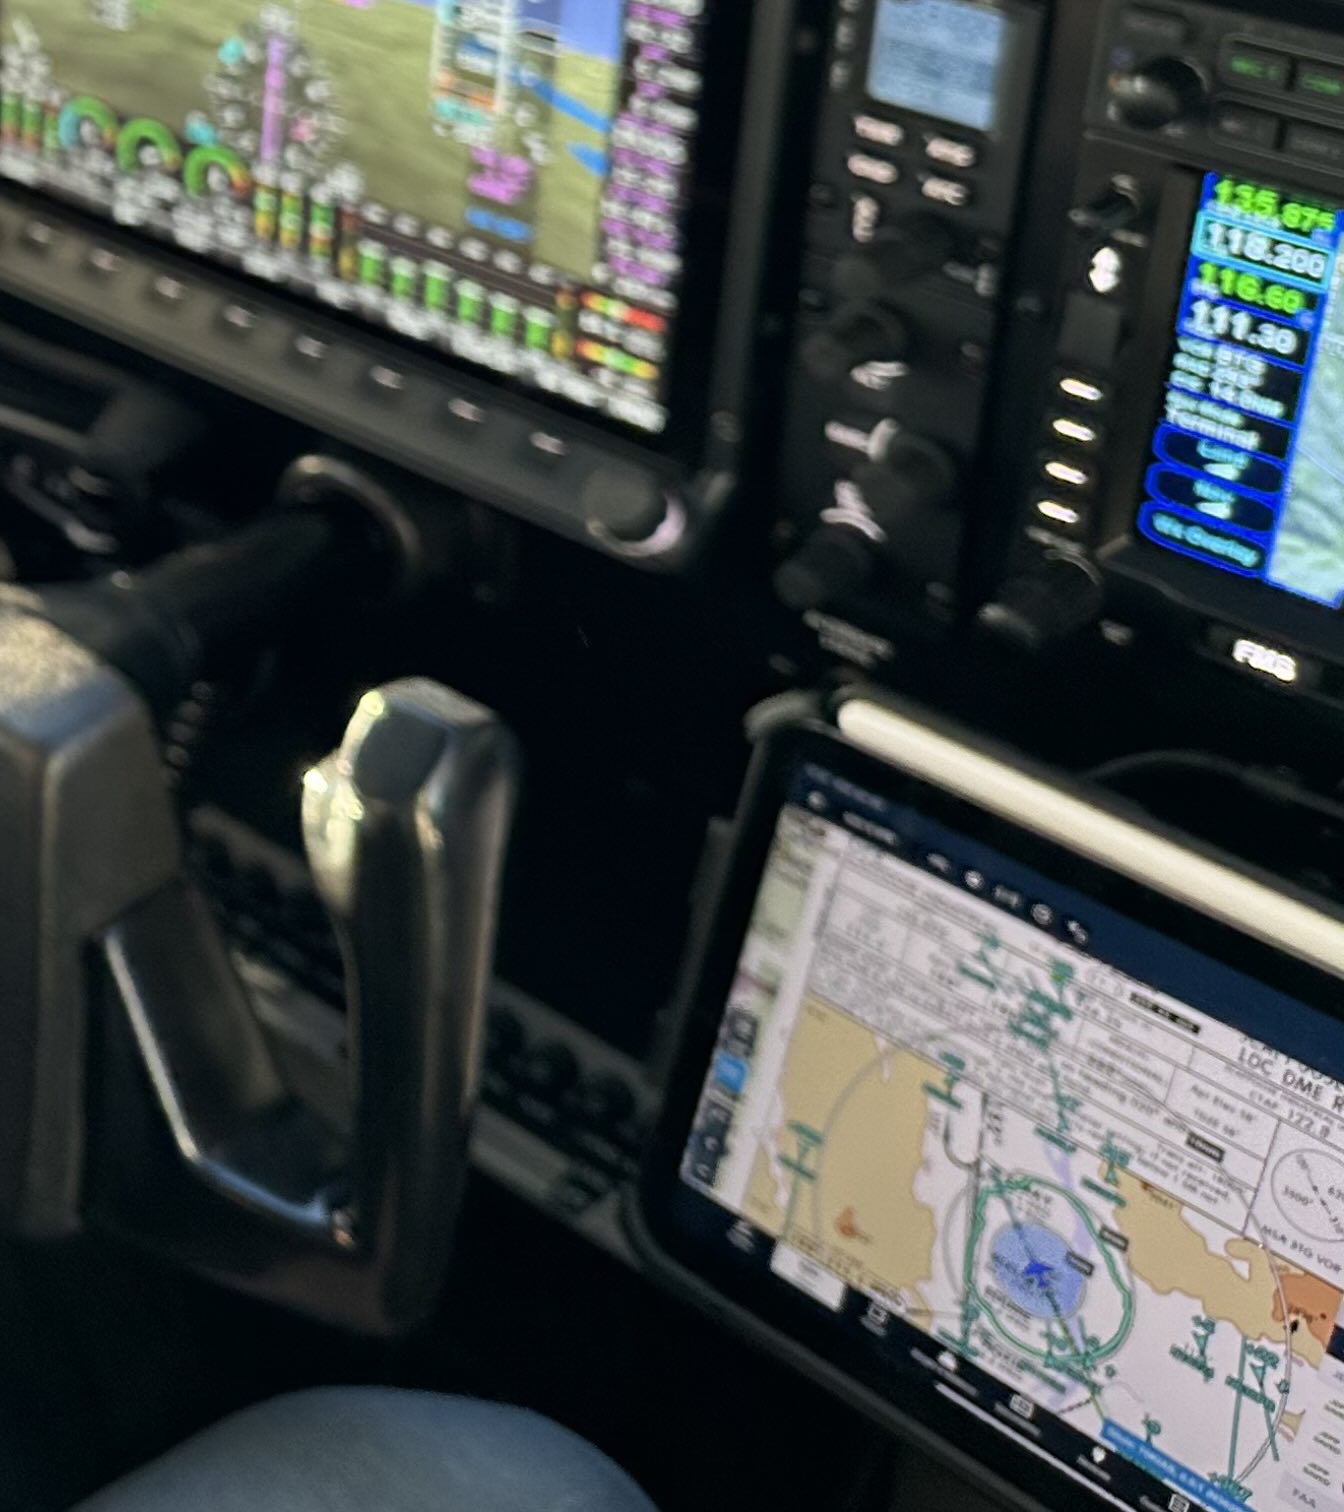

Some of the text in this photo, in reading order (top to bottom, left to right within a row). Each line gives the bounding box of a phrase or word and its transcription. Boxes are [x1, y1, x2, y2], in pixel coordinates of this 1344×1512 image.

[1206, 222, 1326, 279] 118.200
[1190, 299, 1299, 355] 111.30
[1238, 1045, 1274, 1076] LOC
[1282, 1068, 1322, 1102] DME
